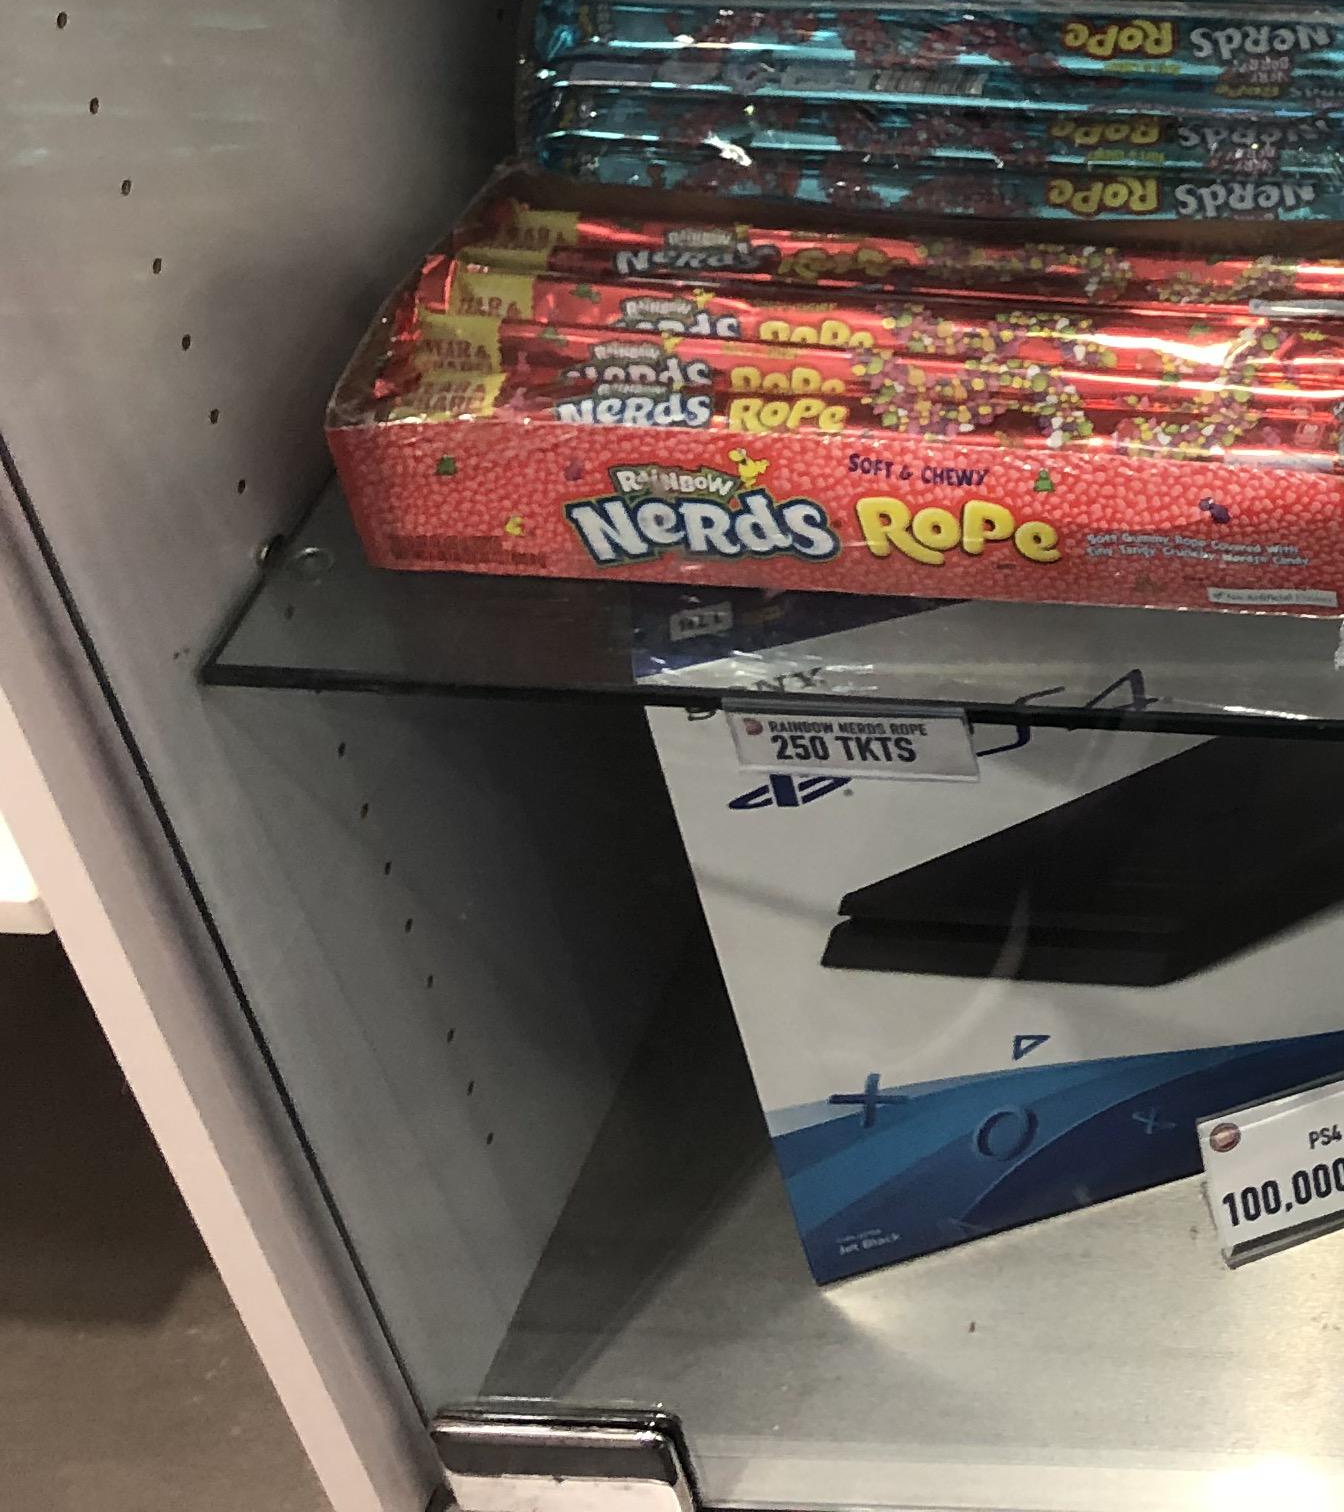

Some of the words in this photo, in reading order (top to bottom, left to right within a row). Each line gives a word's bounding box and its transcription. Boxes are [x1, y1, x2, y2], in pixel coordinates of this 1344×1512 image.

[848, 453, 895, 481] SOFT
[921, 465, 990, 487] CHEWY
[768, 720, 834, 736] RAINBOW
[838, 721, 888, 736] NERDS
[890, 721, 928, 737] ROPE
[774, 734, 830, 761] 250
[835, 735, 917, 763] TKTS
[1308, 1124, 1342, 1149] PS4
